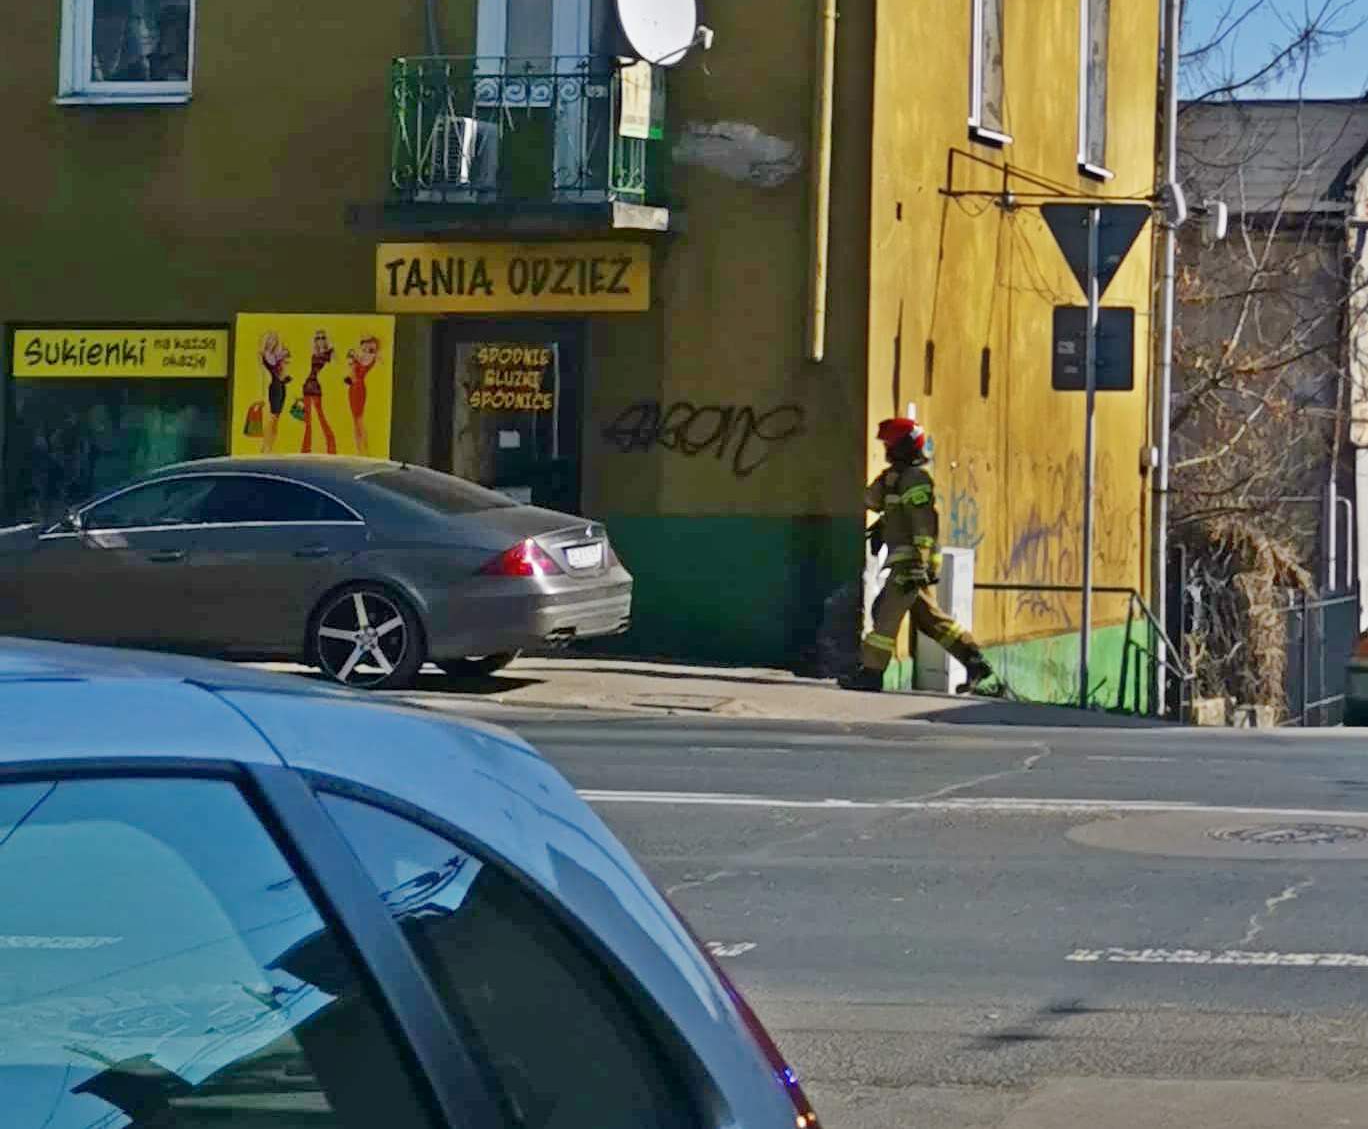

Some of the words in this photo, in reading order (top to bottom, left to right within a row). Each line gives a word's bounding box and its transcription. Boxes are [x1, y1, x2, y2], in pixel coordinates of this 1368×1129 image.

[384, 257, 494, 297] TANIA
[507, 254, 632, 297] ODZIEŻ
[24, 337, 147, 367] Sukienki
[478, 348, 551, 366] SPODNIE
